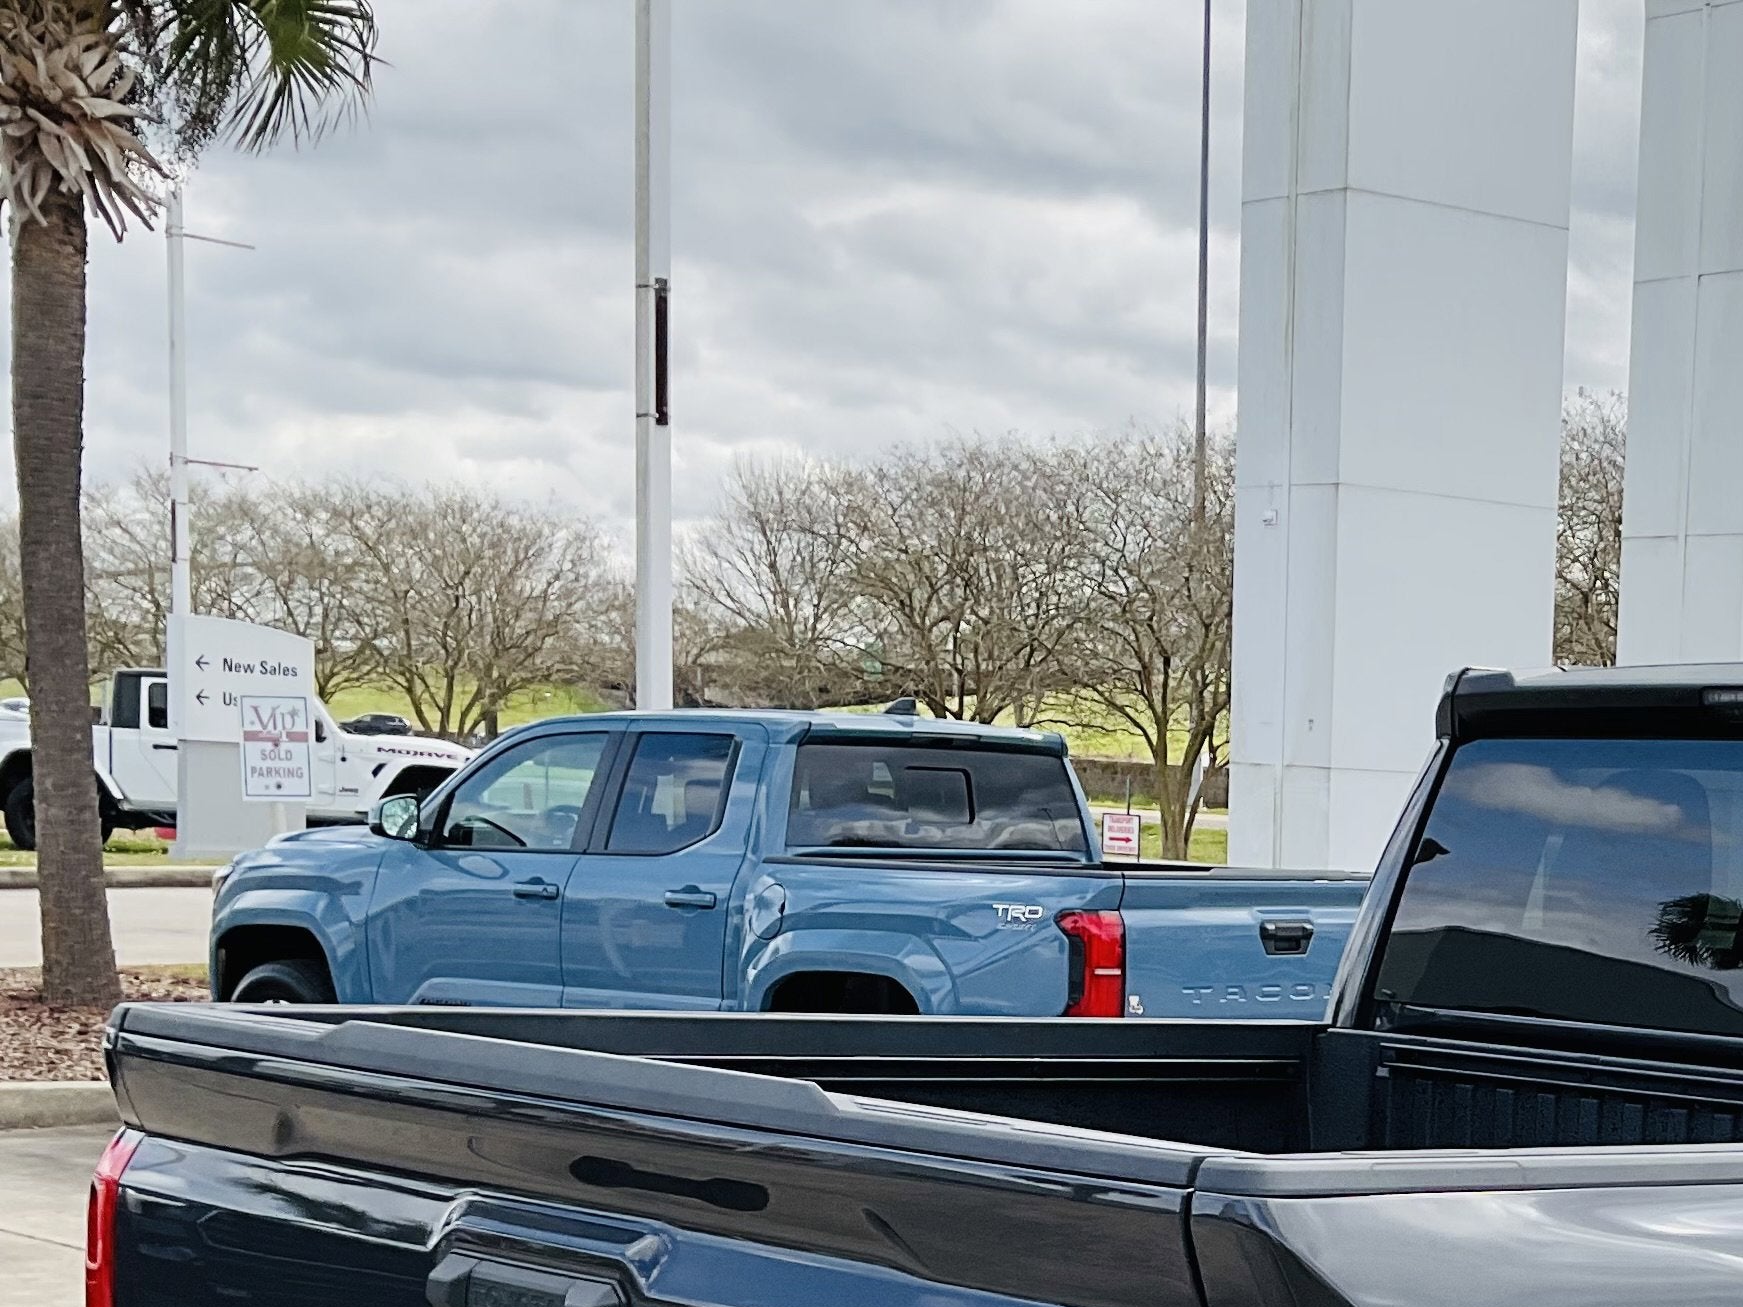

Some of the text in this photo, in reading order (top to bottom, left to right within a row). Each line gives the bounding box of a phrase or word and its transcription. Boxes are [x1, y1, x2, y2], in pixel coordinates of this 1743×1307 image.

[222, 657, 298, 677] New Sales
[259, 748, 293, 762] SOLD
[250, 766, 305, 779] PARKING
[992, 904, 1043, 922] TRD
[1182, 983, 1331, 1005] TACO
